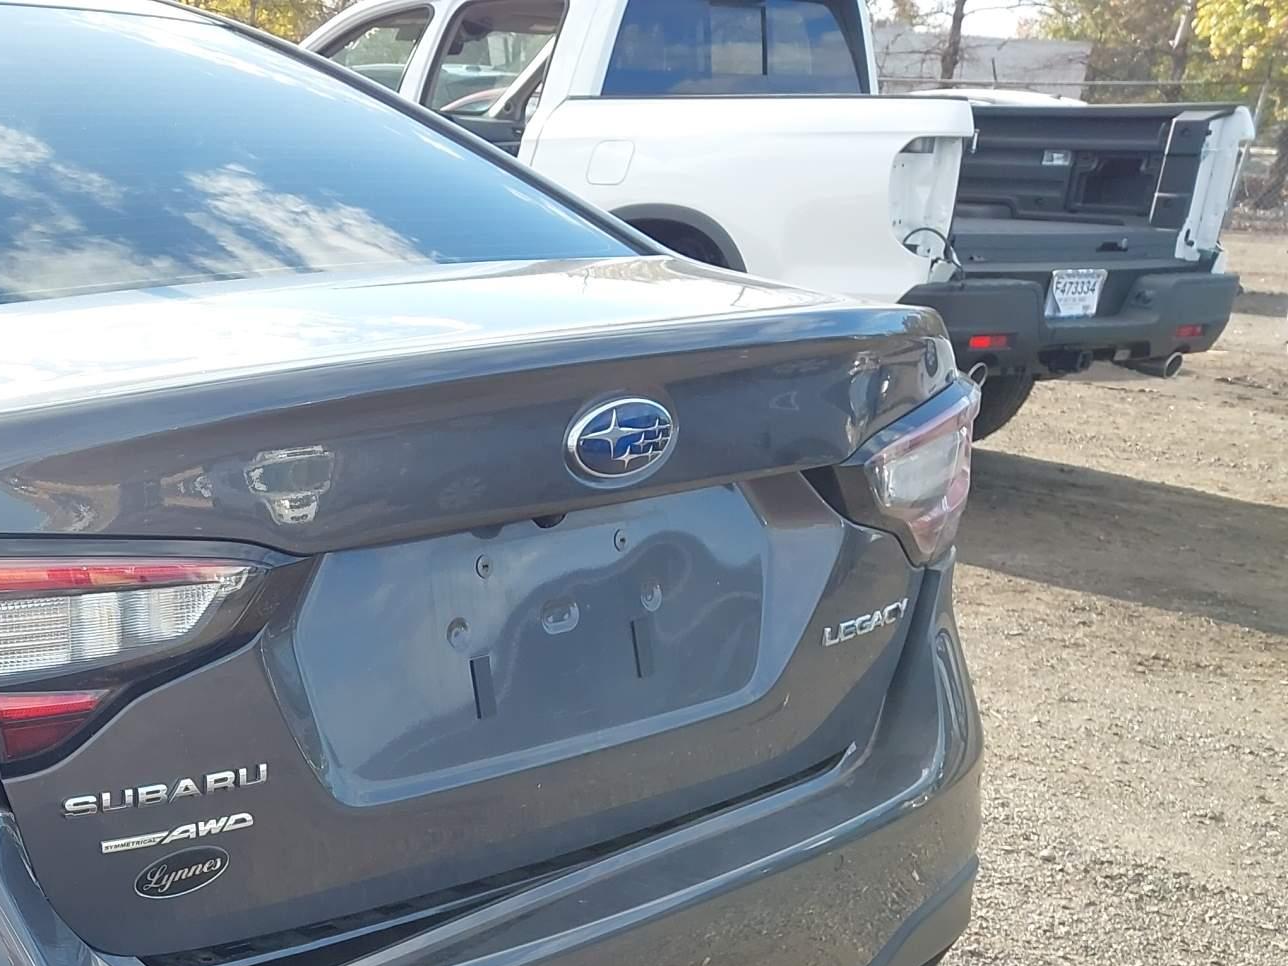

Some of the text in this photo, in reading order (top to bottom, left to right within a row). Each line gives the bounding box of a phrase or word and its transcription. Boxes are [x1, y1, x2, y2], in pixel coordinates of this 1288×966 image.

[1055, 280, 1096, 296] F473334
[822, 598, 909, 648] LEGACY
[62, 763, 268, 818] SUBARU
[104, 812, 254, 851] SYMMETRICAL AWD
[143, 857, 222, 893] Lynnes
